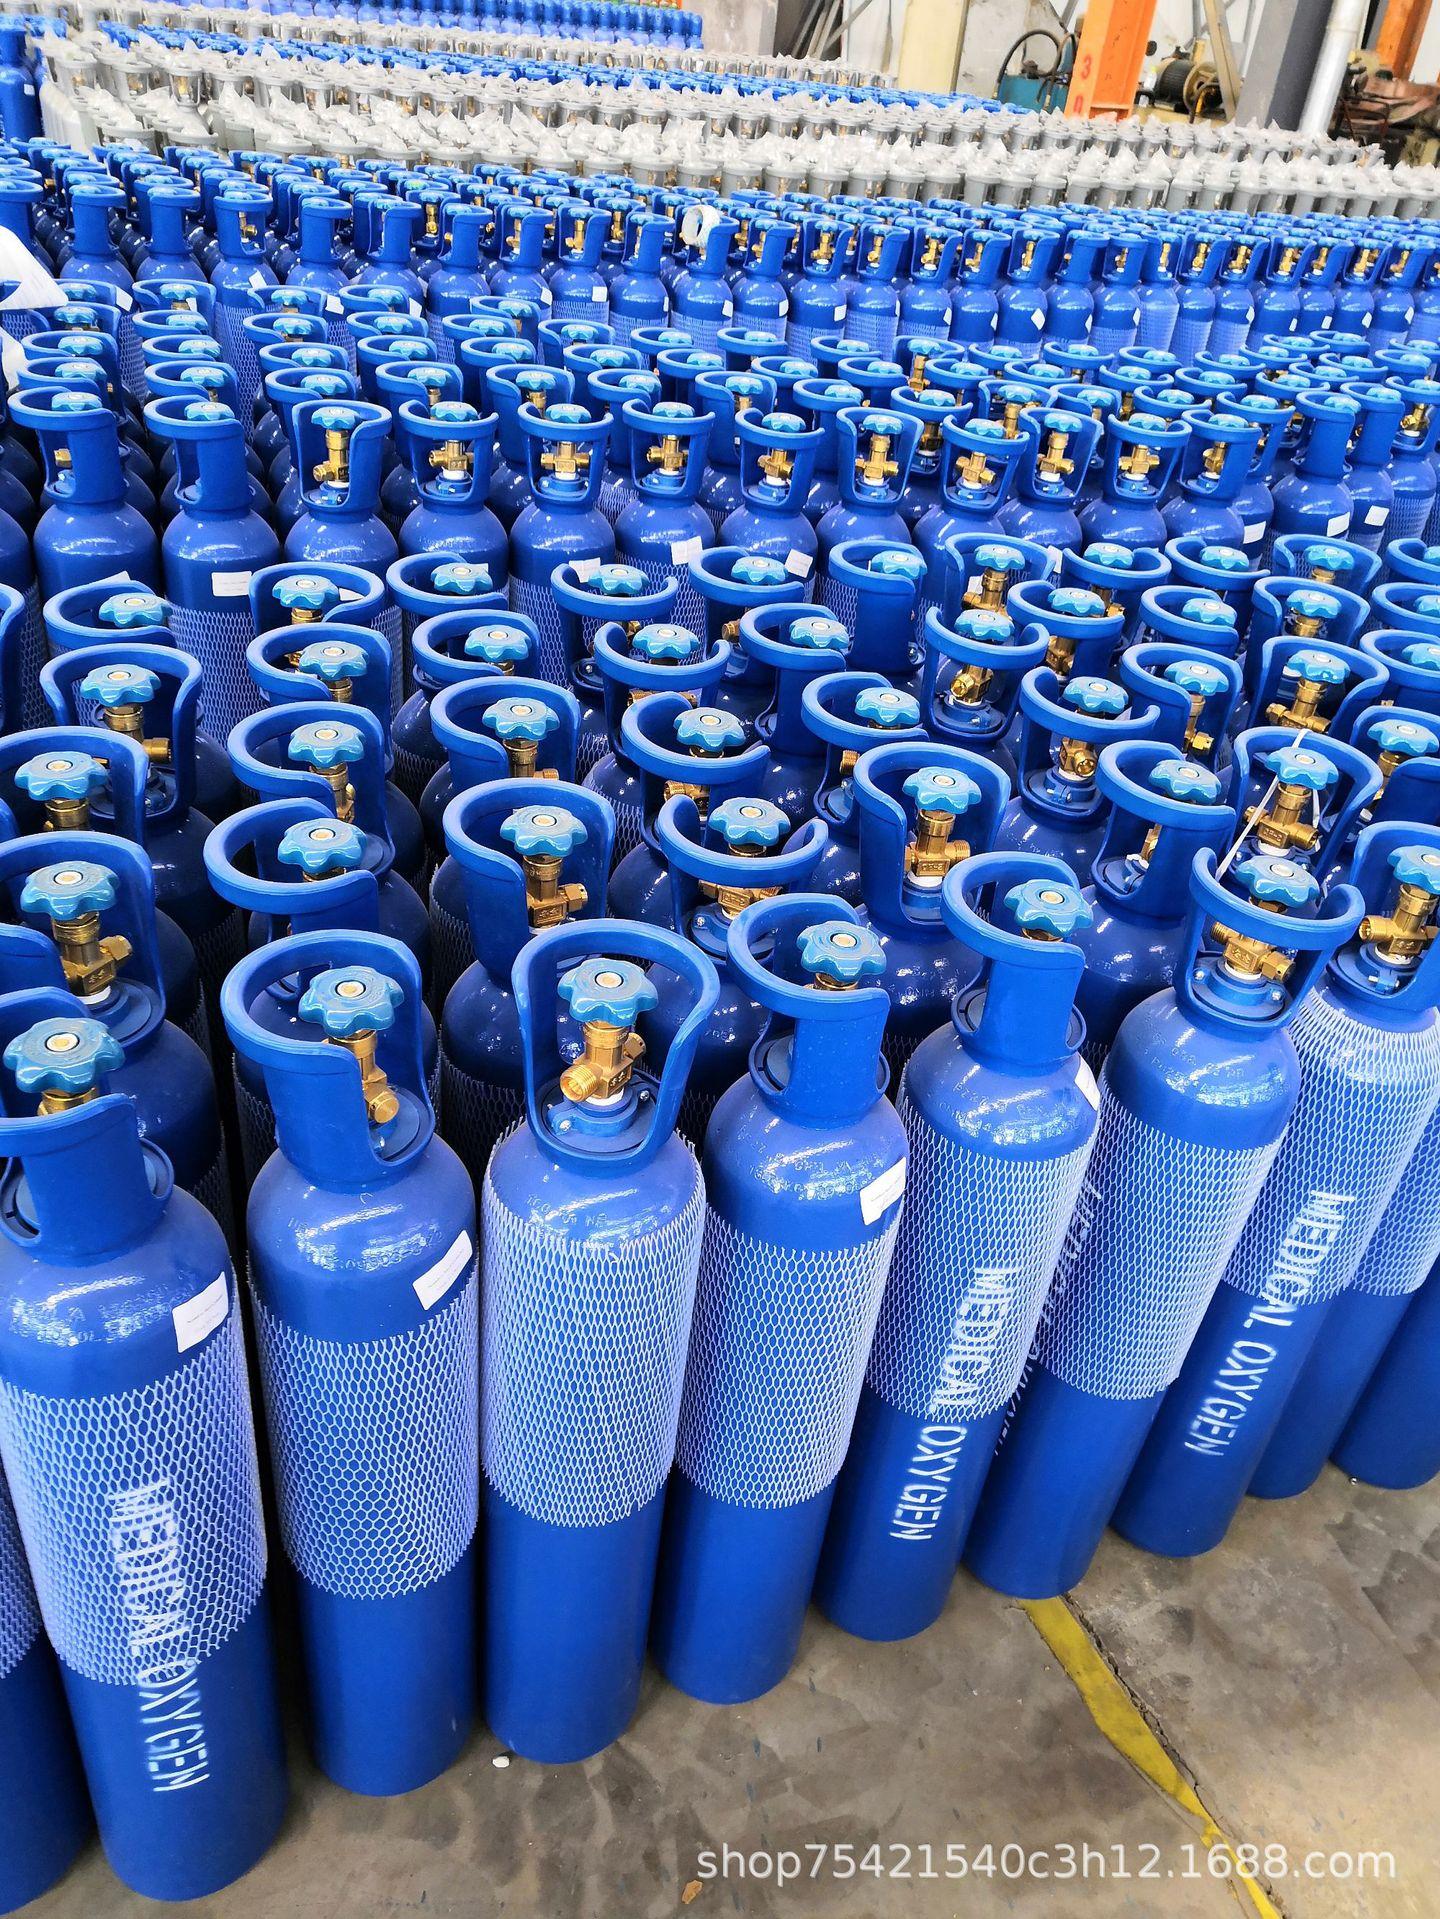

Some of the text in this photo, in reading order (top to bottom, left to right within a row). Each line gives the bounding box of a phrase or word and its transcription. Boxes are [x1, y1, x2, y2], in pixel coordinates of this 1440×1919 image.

[889, 1267, 1020, 1540] MEDICAL OXYGEN
[1184, 1189, 1356, 1457] MEDICAL OXYGEN
[137, 1659, 211, 1792] OXYGEN
